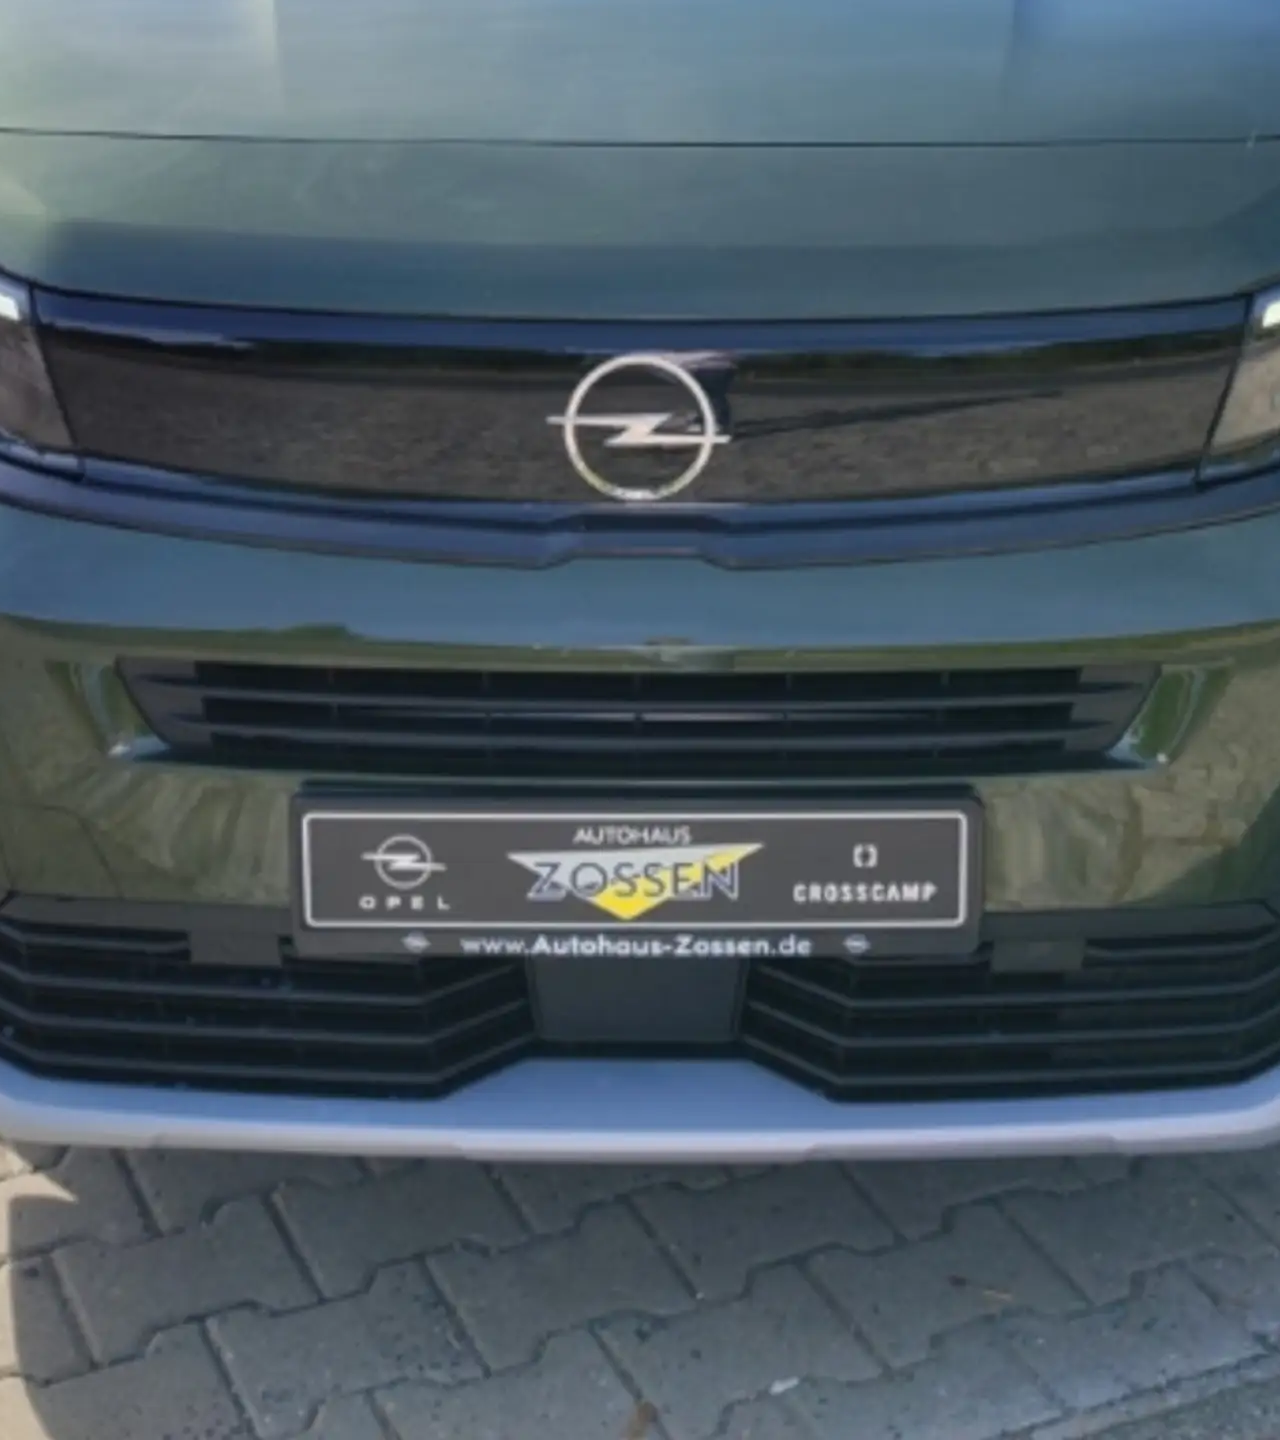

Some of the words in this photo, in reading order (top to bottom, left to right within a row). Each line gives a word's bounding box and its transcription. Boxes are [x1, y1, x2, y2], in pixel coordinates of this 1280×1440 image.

[572, 825, 693, 846] AUTOHAUS
[527, 859, 741, 902] ZOSSEN
[358, 895, 451, 911] OPEL
[792, 881, 938, 903] CROSSCAMP
[459, 933, 813, 958] www.Autohaus-Zossen.de
